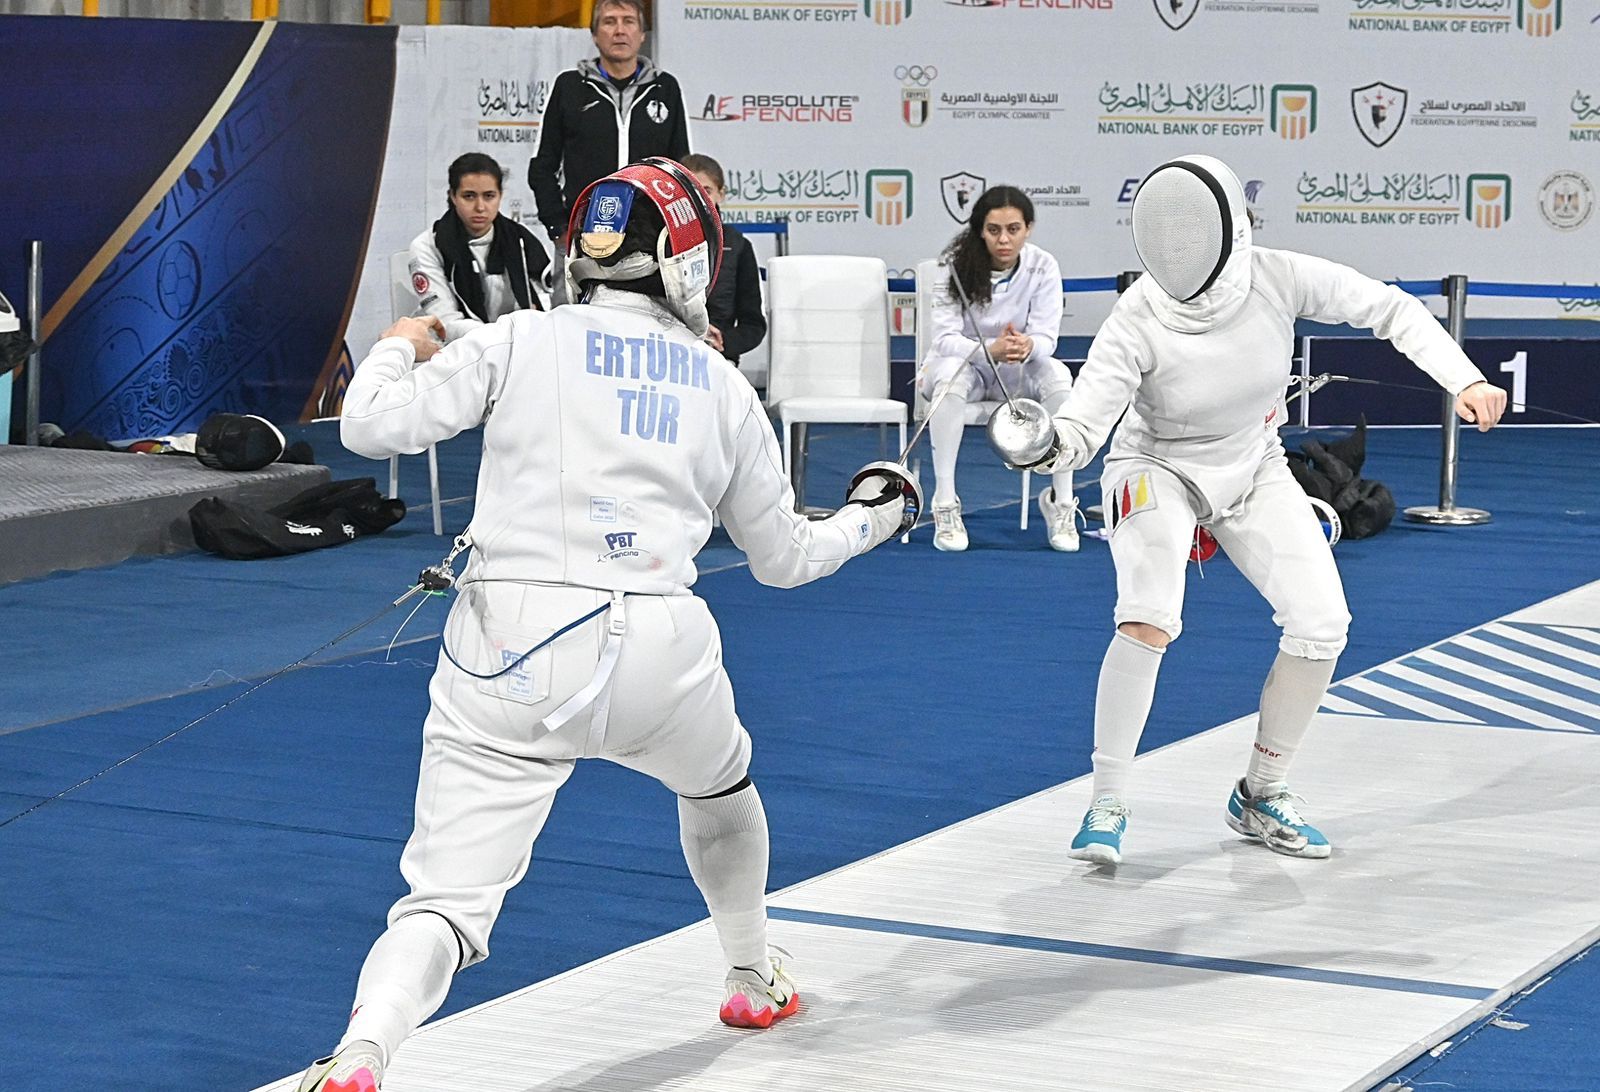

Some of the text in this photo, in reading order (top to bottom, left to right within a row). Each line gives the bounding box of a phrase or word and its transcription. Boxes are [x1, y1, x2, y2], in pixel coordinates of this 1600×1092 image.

[684, 8, 858, 22] NATIONAL BANK OF EGYPT
[1349, 18, 1510, 33] NATIONAL BANK OF EGYPT
[742, 107, 853, 122] FENCING
[952, 111, 976, 119] EGYPT
[978, 111, 1009, 119] OLYMPIC
[478, 129, 514, 143] NATIONAL
[1098, 122, 1264, 136] NATIONAL BANK OF EGYPT
[1569, 130, 1600, 141] NATIO
[664, 197, 697, 229] TUR
[720, 210, 749, 223] ONAL
[795, 210, 813, 223] OF
[816, 210, 859, 223] EGYPT
[1296, 211, 1460, 225] NATIONAL BANK OF EGYPT
[586, 329, 711, 392] ERTÜRK
[1500, 351, 1527, 413] 1
[617, 384, 680, 445] TÜR
[604, 531, 637, 551] PBT
